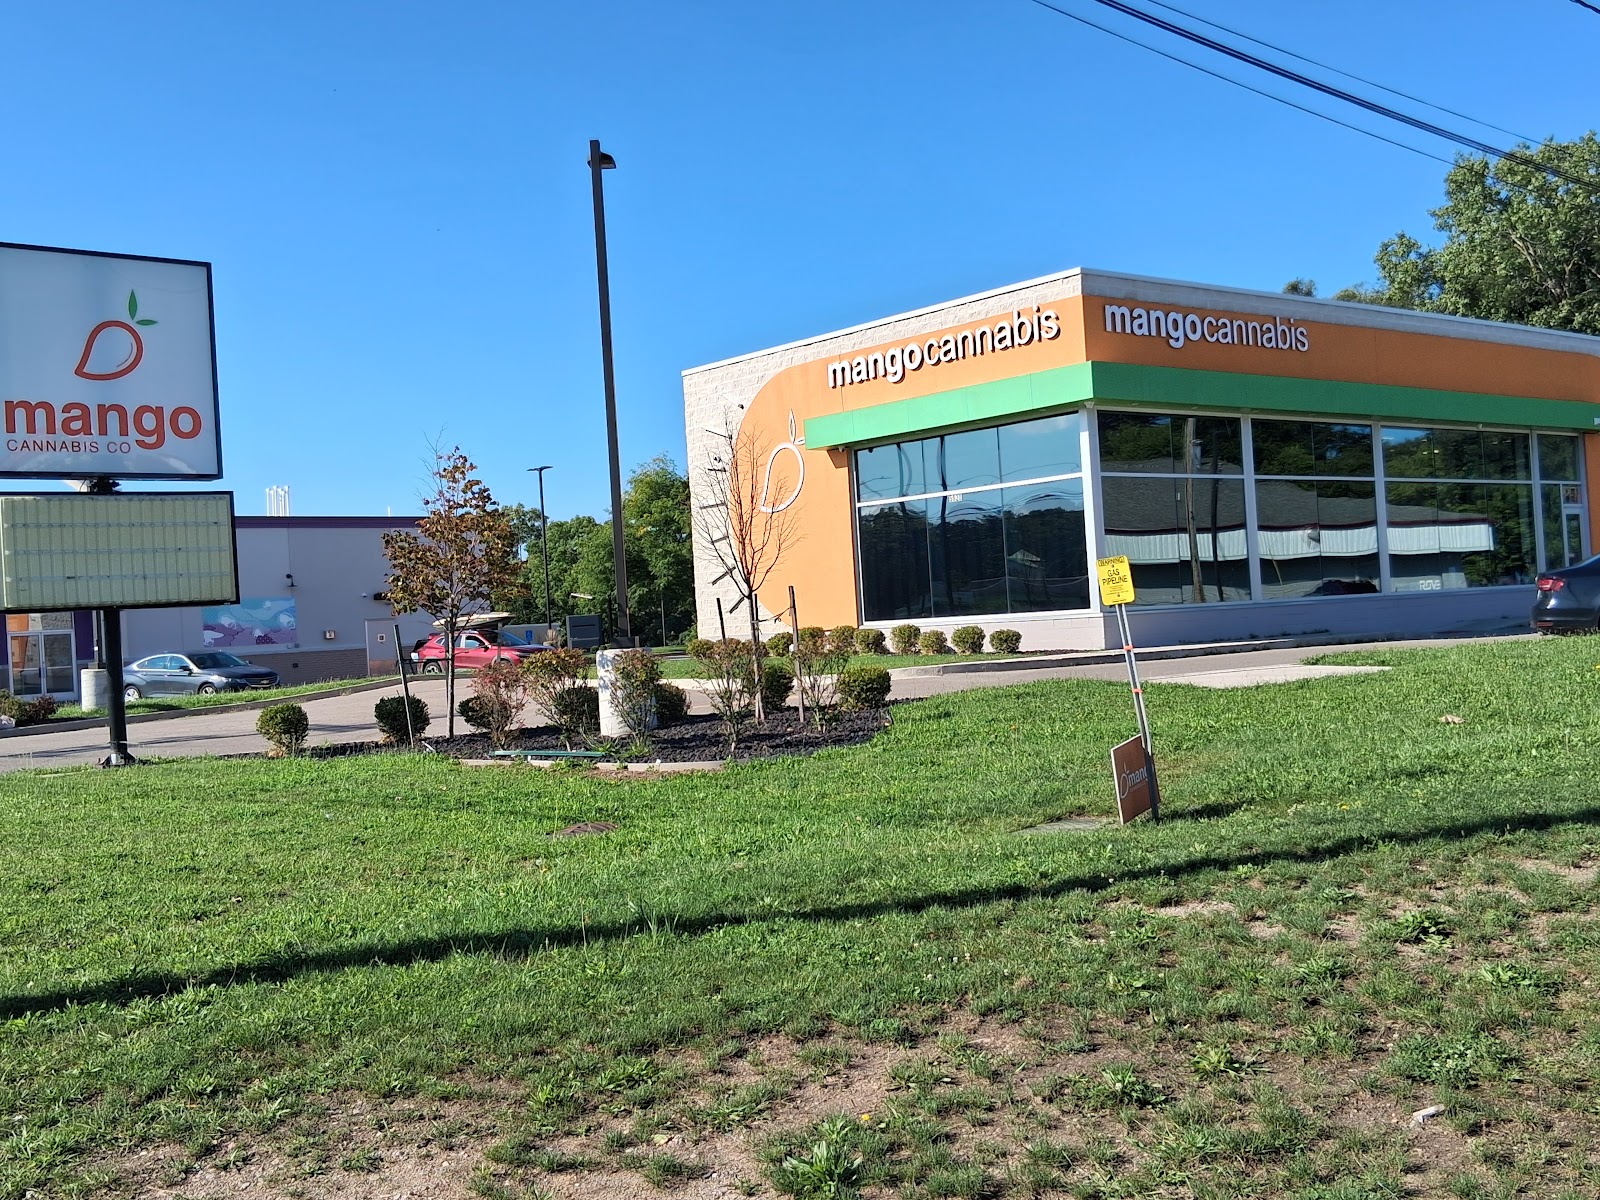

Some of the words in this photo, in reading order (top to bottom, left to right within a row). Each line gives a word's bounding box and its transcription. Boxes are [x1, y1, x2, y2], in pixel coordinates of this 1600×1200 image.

[1104, 304, 1310, 352] mangocannabis
[827, 306, 1060, 389] mangocannabis
[4, 399, 203, 450] mango
[6, 439, 99, 454] CANNABIS
[106, 441, 131, 454] CO
[1102, 574, 1128, 586] PIPELINE
[1107, 568, 1120, 577] GAS
[1128, 764, 1153, 787] man
